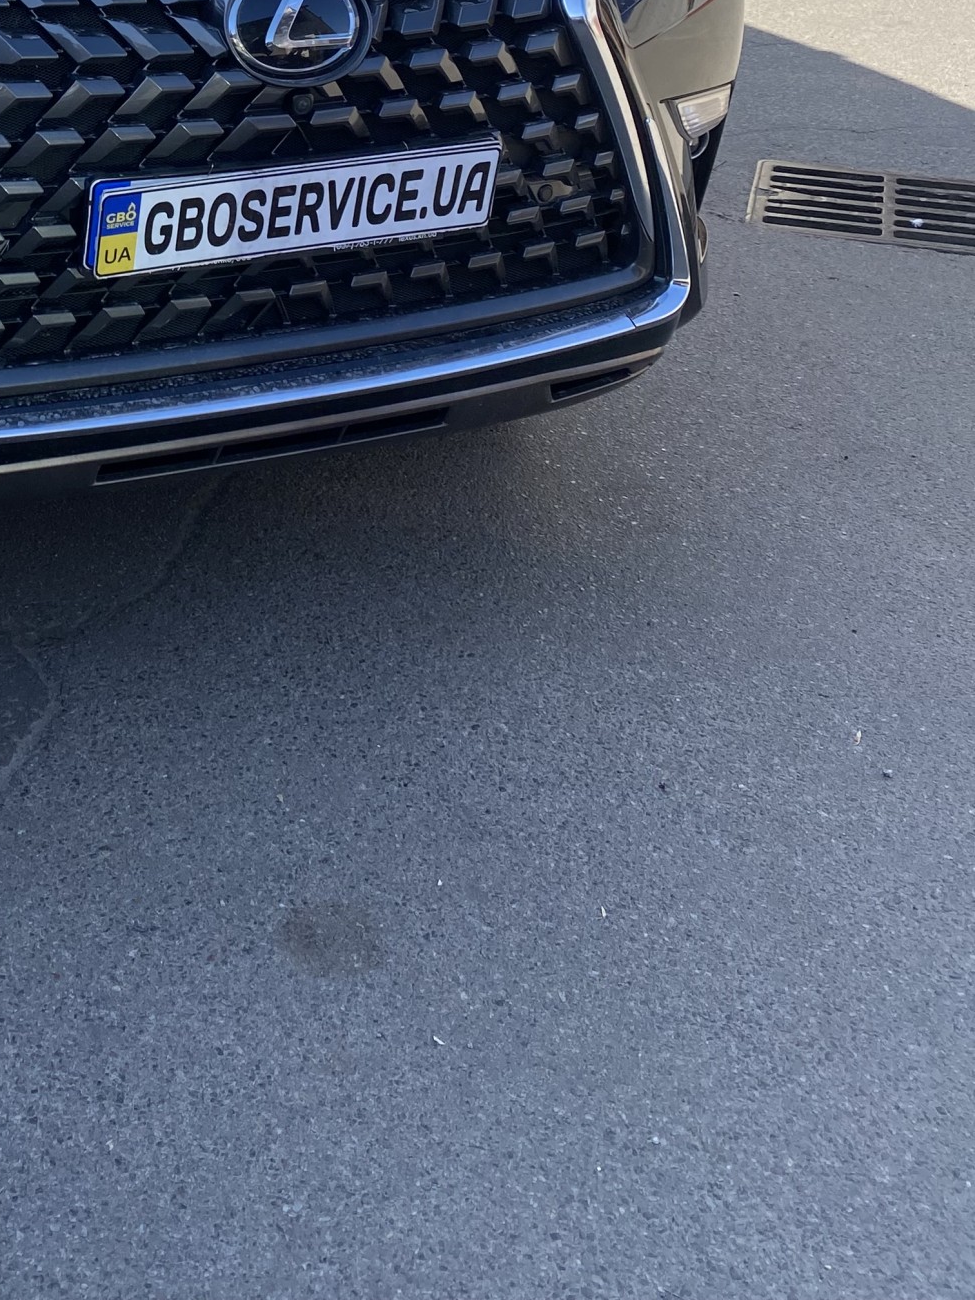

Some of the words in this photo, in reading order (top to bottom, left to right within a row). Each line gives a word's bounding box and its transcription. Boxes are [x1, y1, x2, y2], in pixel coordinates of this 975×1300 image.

[106, 209, 137, 224] GBO
[144, 161, 492, 256] GBOSERVICE.UA
[106, 220, 135, 230] SERVICE
[105, 246, 131, 264] UA
